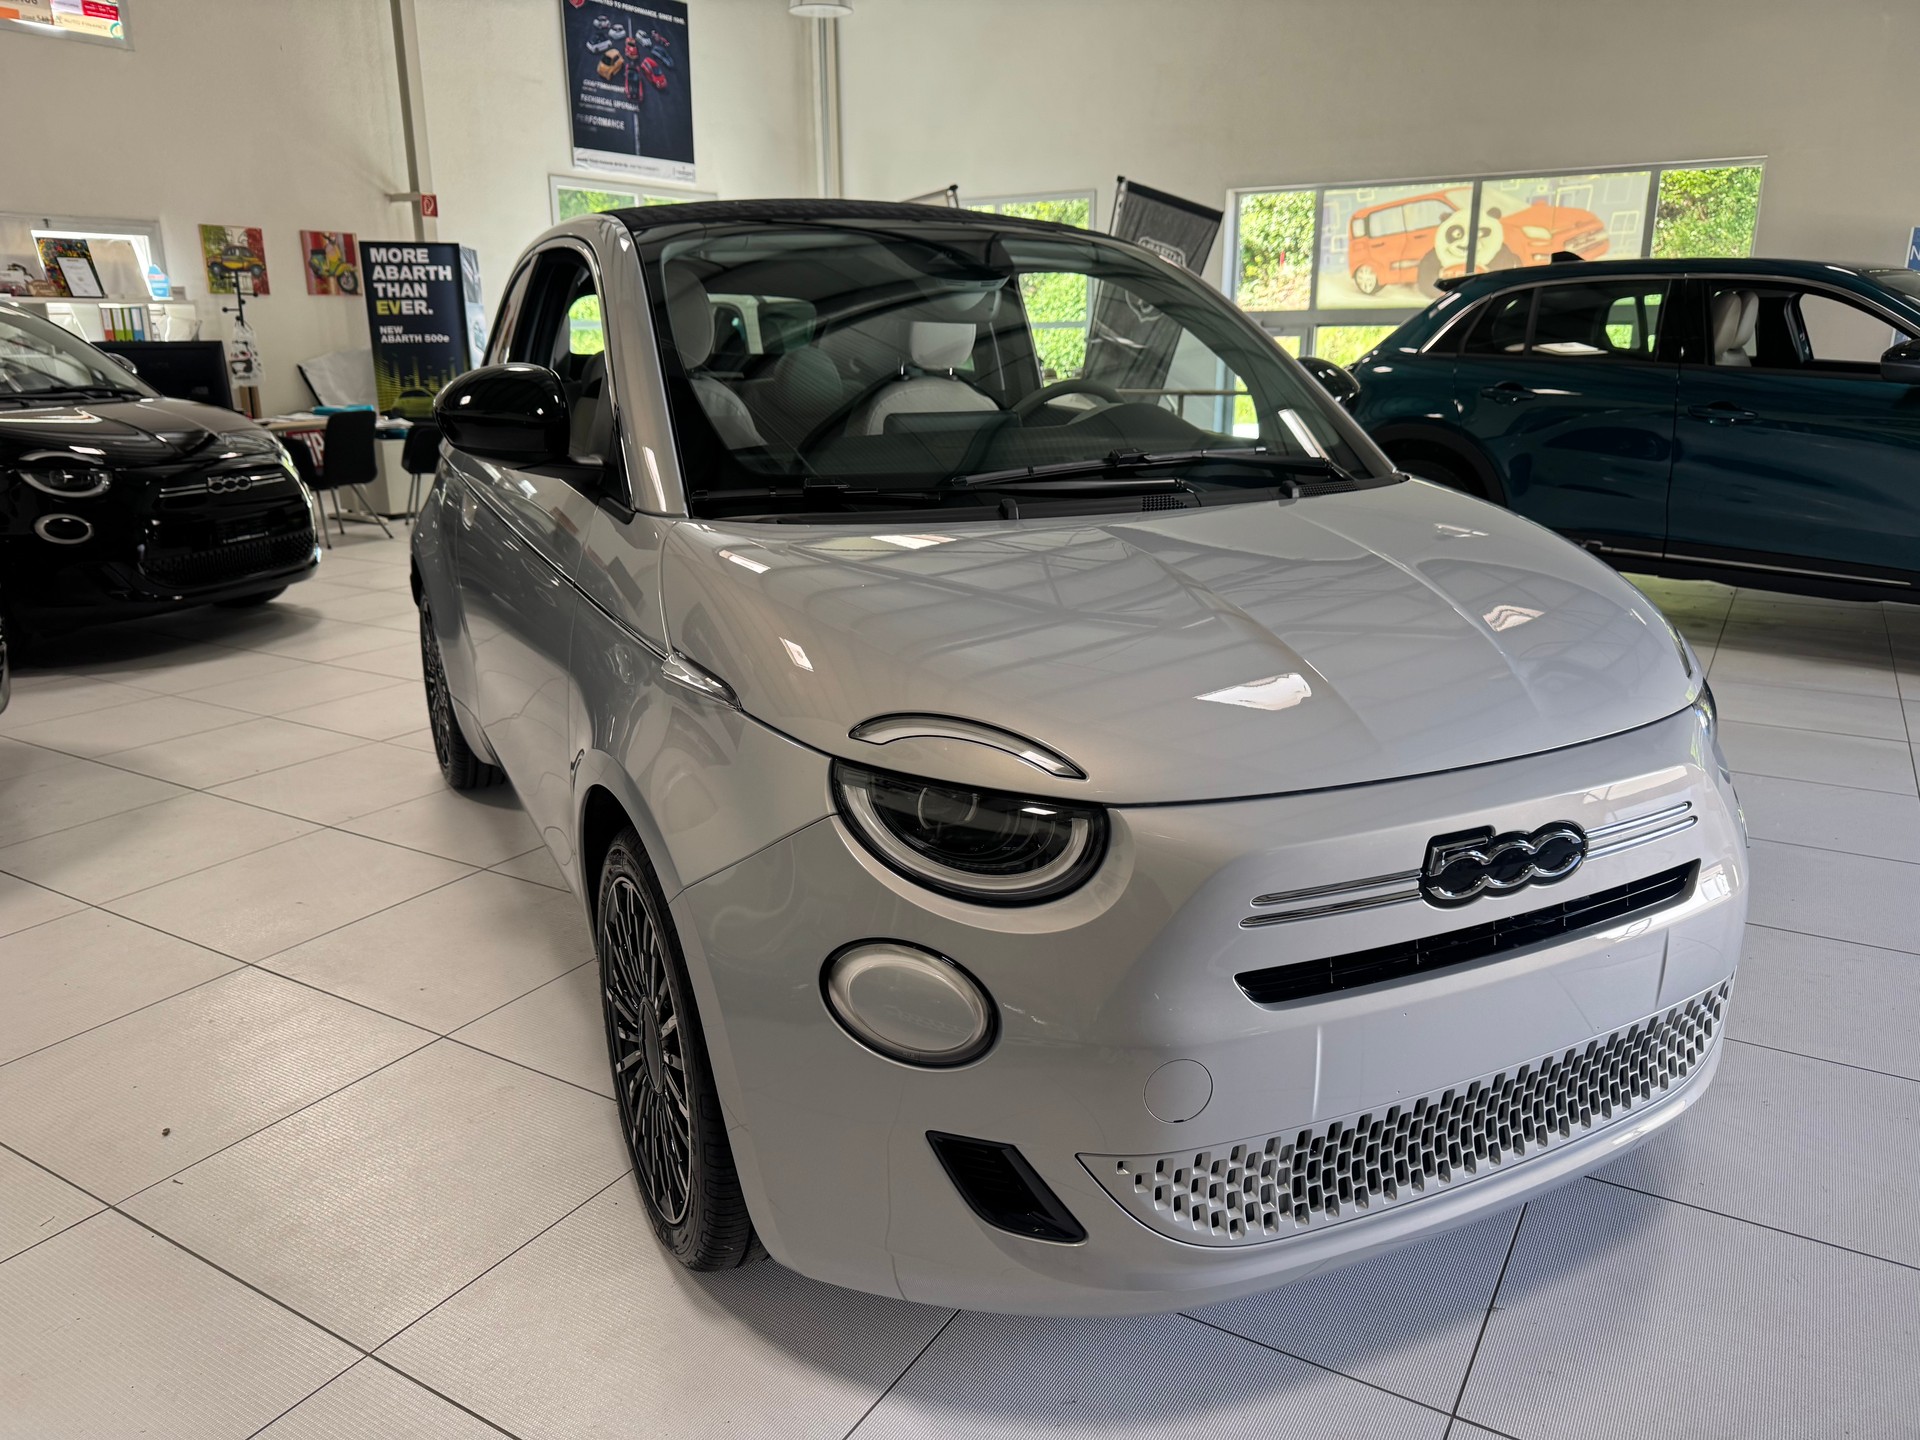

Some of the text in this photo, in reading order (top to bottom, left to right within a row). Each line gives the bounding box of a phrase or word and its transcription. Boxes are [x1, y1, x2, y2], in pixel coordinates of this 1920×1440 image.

[369, 247, 429, 263] MORE
[372, 265, 452, 281] ABARTH
[373, 282, 428, 298] THAN
[376, 300, 434, 315] EVER.
[379, 326, 404, 335] NEW
[381, 333, 450, 343] ABARTH 500e
[208, 475, 251, 494] 500
[1422, 824, 1585, 904] 500
